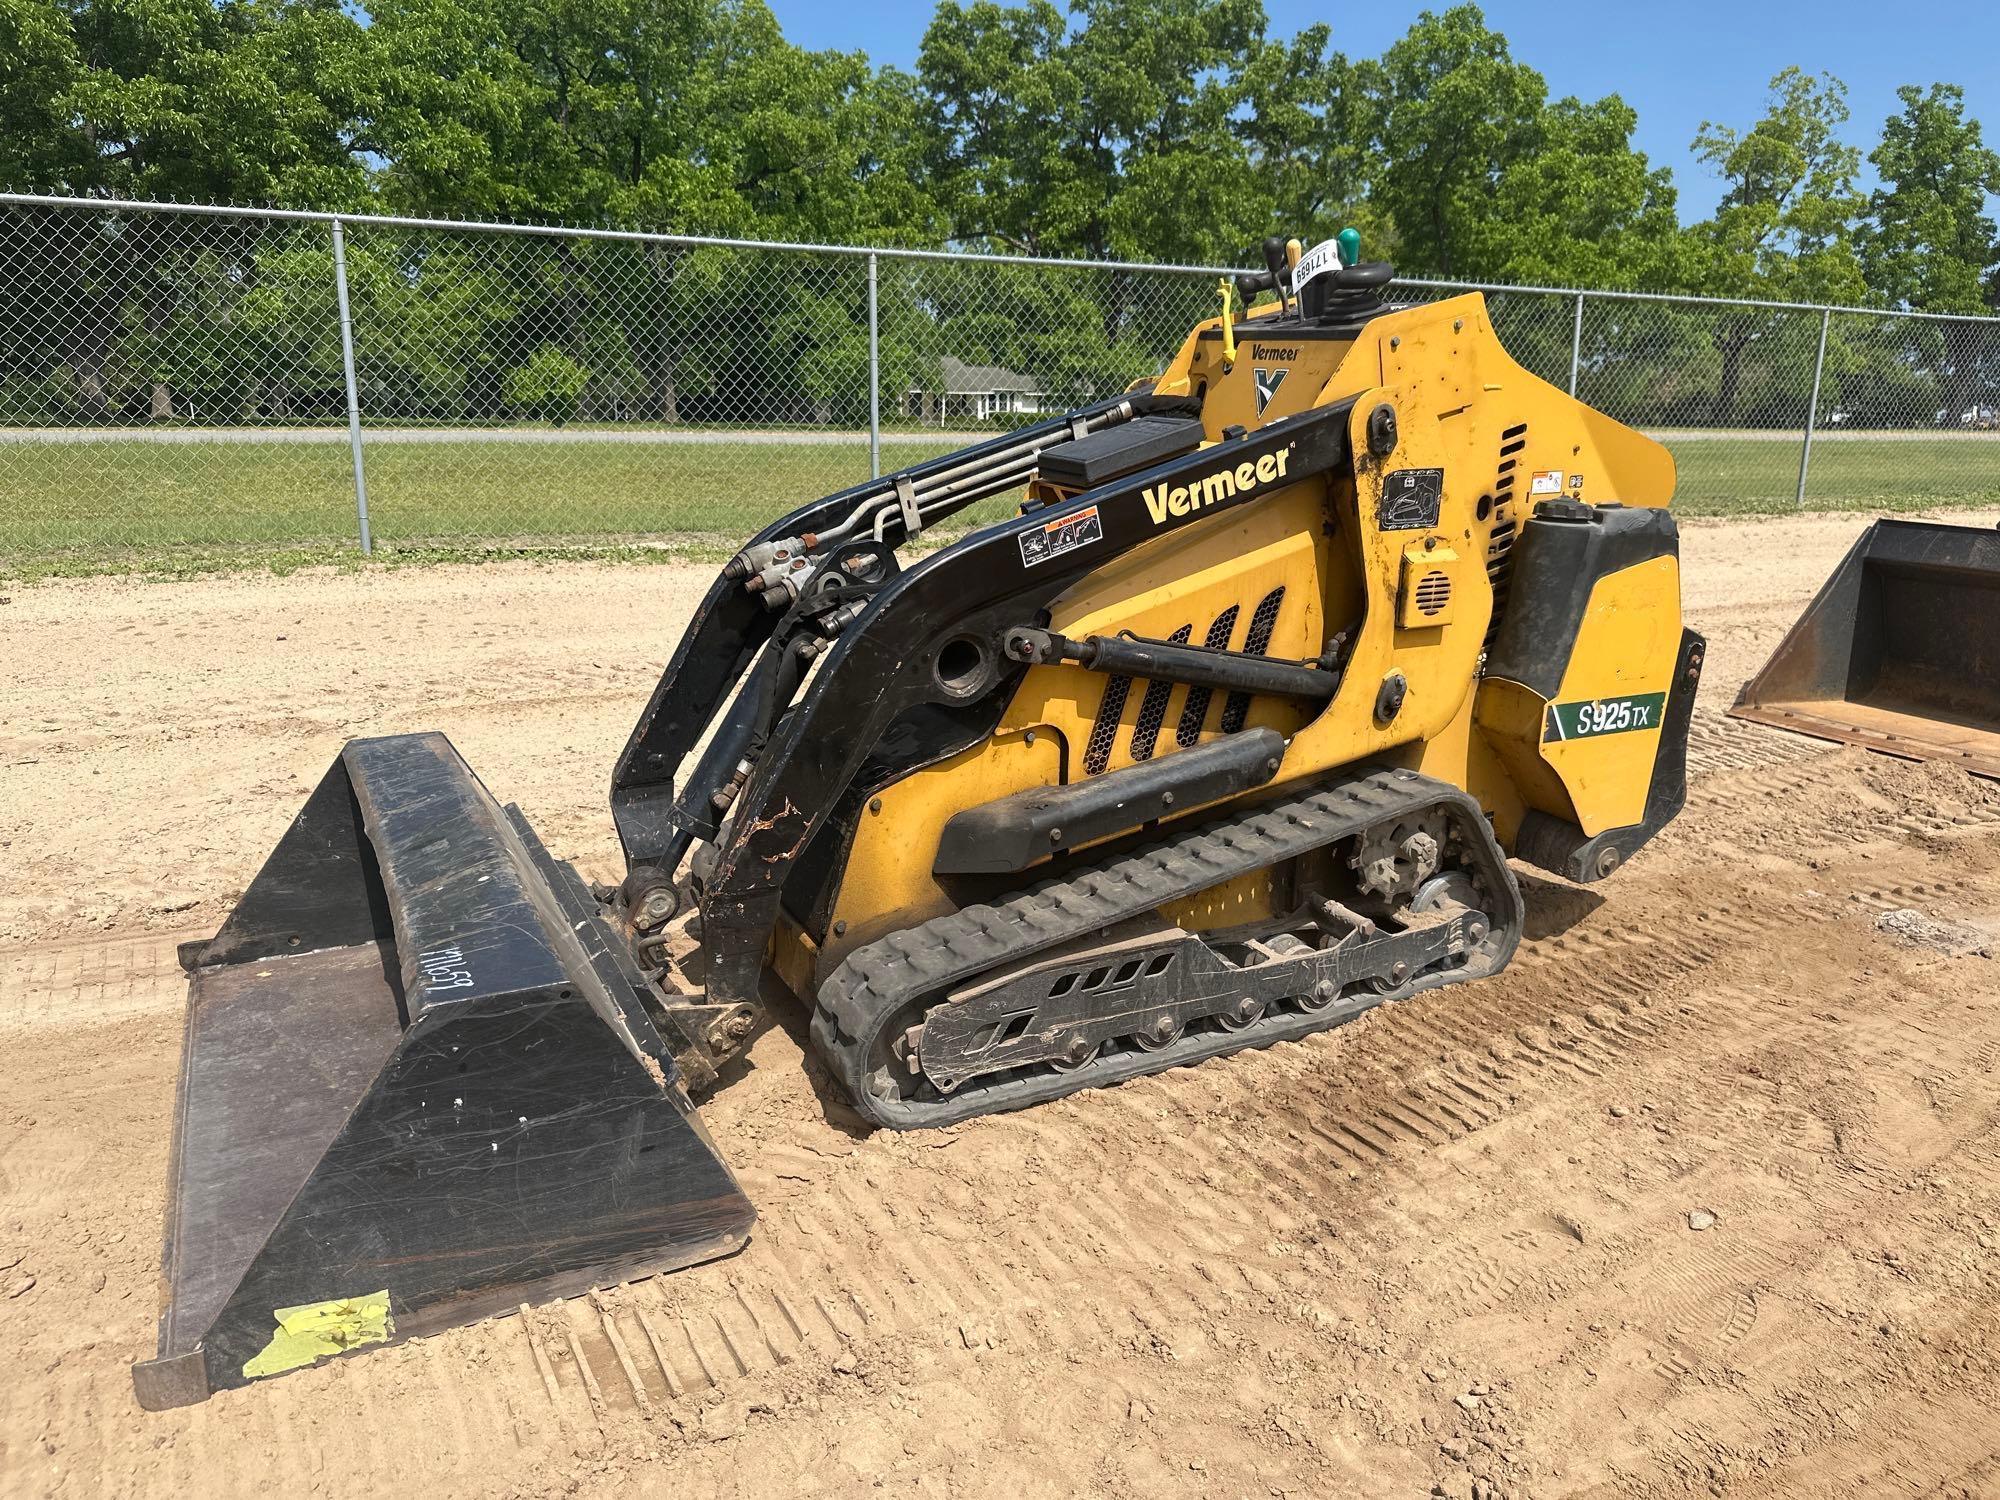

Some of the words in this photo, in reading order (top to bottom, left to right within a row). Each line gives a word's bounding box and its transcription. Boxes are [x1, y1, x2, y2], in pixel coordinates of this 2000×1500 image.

[1296, 252, 1328, 284] 171659
[1252, 344, 1299, 361] Vermeer
[1141, 447, 1290, 525] Vermeer
[1062, 512, 1087, 525] WARNING
